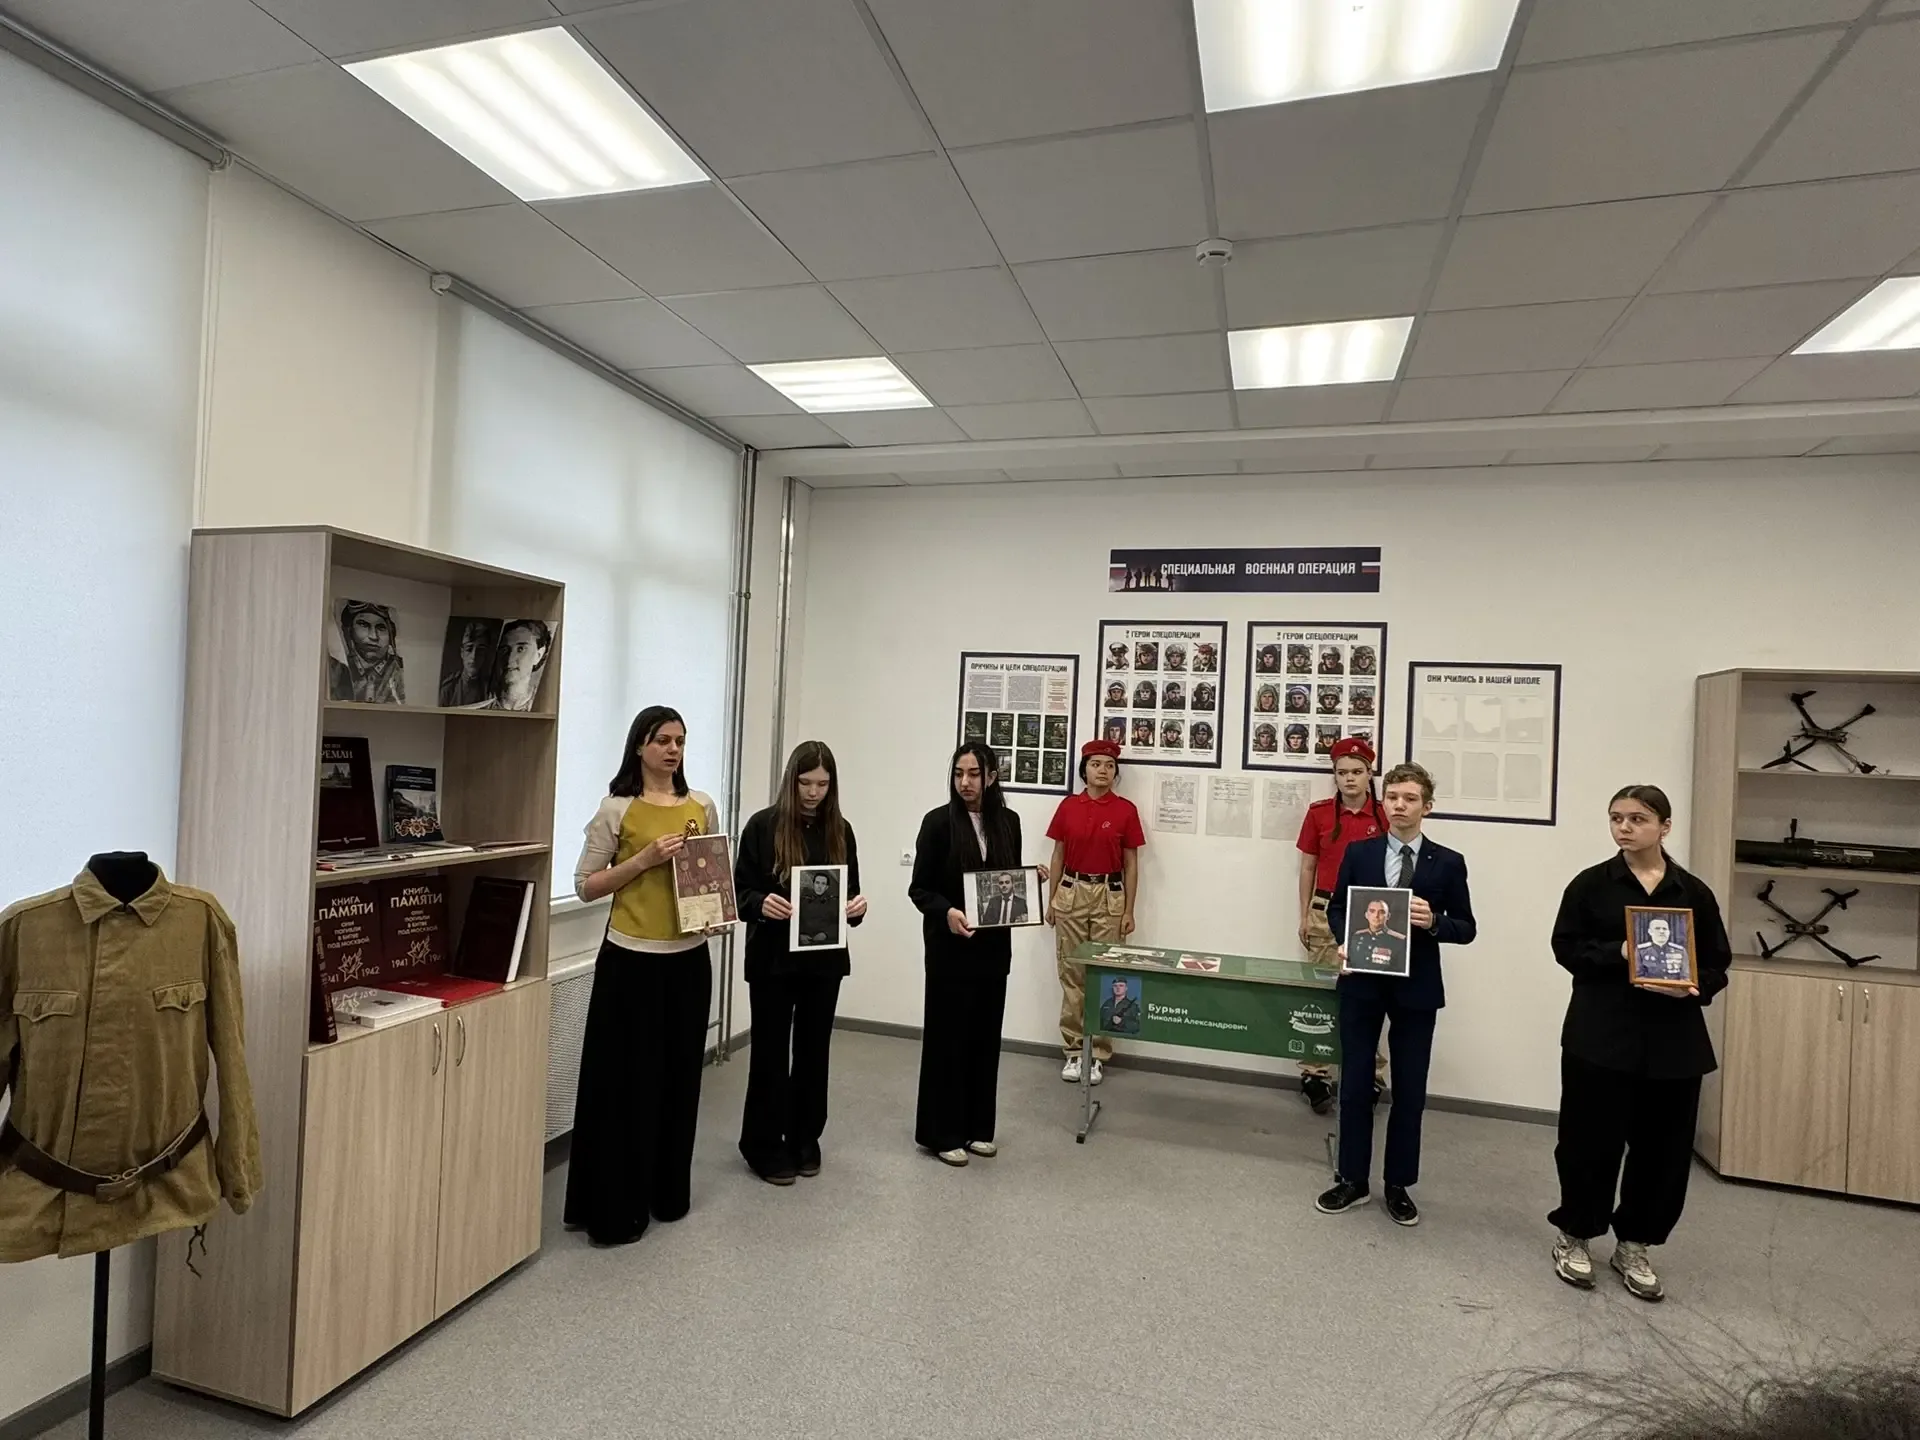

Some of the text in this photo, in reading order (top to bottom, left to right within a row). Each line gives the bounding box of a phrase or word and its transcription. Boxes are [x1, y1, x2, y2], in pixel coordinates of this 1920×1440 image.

[1161, 562, 1356, 576] СПЕЦИАЛЬНАЯ ВОЕННАЯ ОПЕРАЦИЯ
[1152, 631, 1200, 639] СПЕЦОПЕРАЦИИ
[1306, 633, 1358, 641] СПЕЦОПЕРАЦИИ
[1022, 664, 1068, 672] СПЕЦОПЕРАЦИИ
[1444, 675, 1476, 683] УЧИЛИСЬ
[1486, 675, 1511, 684] НАШЕЙ
[1514, 677, 1540, 685] ШКОЛЕ
[403, 886, 430, 896] КНИГА
[332, 896, 360, 906] КНИГА
[391, 893, 442, 908] ПАМЯТИ
[319, 902, 374, 920] ПАМЯТИ
[391, 958, 408, 968] 1941
[361, 966, 380, 977] 1942
[1148, 1003, 1188, 1015] Бурьян
[1148, 1013, 1248, 1030] Николай Александрович
